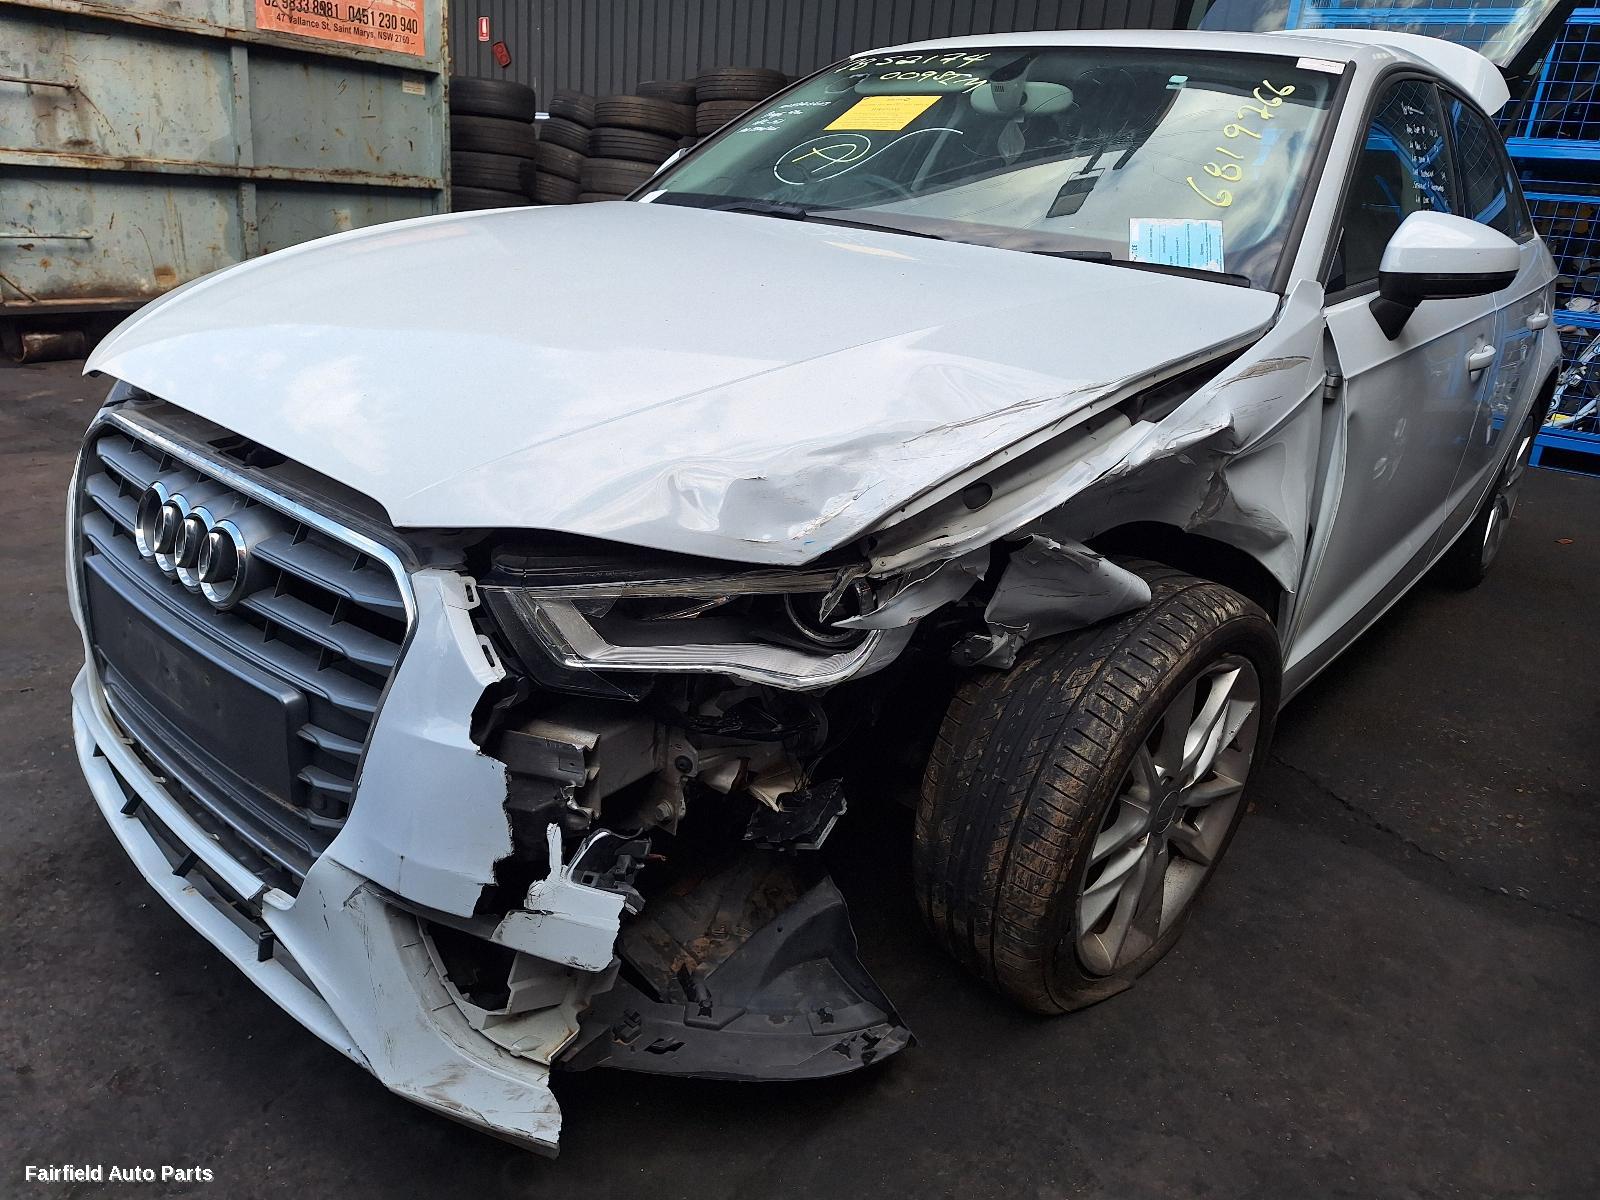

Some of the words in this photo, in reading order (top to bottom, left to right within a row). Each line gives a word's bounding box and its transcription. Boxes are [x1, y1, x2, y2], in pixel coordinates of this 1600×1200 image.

[276, 13, 286, 22] 47
[288, 16, 320, 29] Vallance
[321, 21, 332, 32] St,
[333, 23, 352, 35] Saint
[353, 27, 376, 40] Marys,
[377, 31, 393, 42] NSW
[394, 34, 410, 45] 2760
[348, 5, 375, 26] 0451
[378, 12, 397, 30] 230
[400, 16, 418, 35] 940
